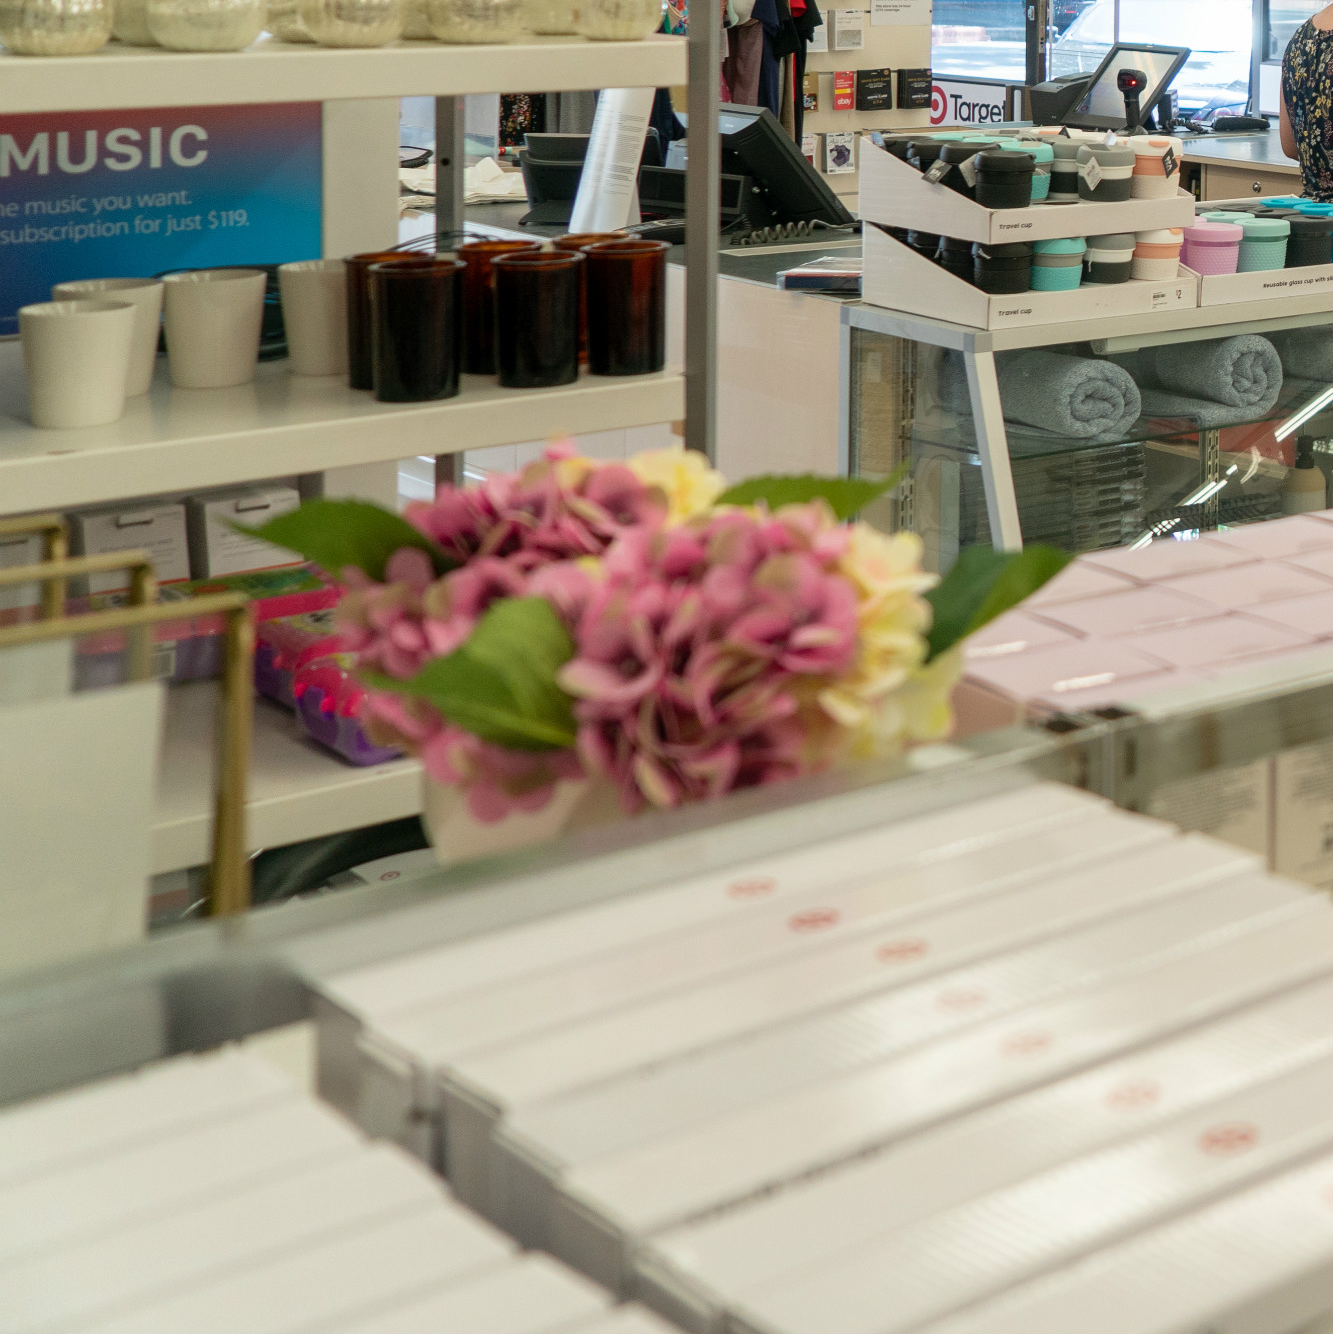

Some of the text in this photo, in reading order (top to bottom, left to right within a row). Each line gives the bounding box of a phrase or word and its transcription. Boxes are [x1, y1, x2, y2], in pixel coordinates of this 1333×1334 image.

[838, 98, 852, 106] ebay
[950, 94, 1006, 123] Target
[0, 125, 208, 177] MUSIC
[25, 195, 88, 214] music
[93, 196, 131, 215] you
[137, 190, 192, 208] want.
[1, 209, 250, 244] subscription for just $119.
[1263, 280, 1287, 289] Reusable
[1289, 279, 1302, 287] glass
[1315, 276, 1327, 284] with
[1176, 289, 1182, 299] $2
[1020, 308, 1032, 316] cup
